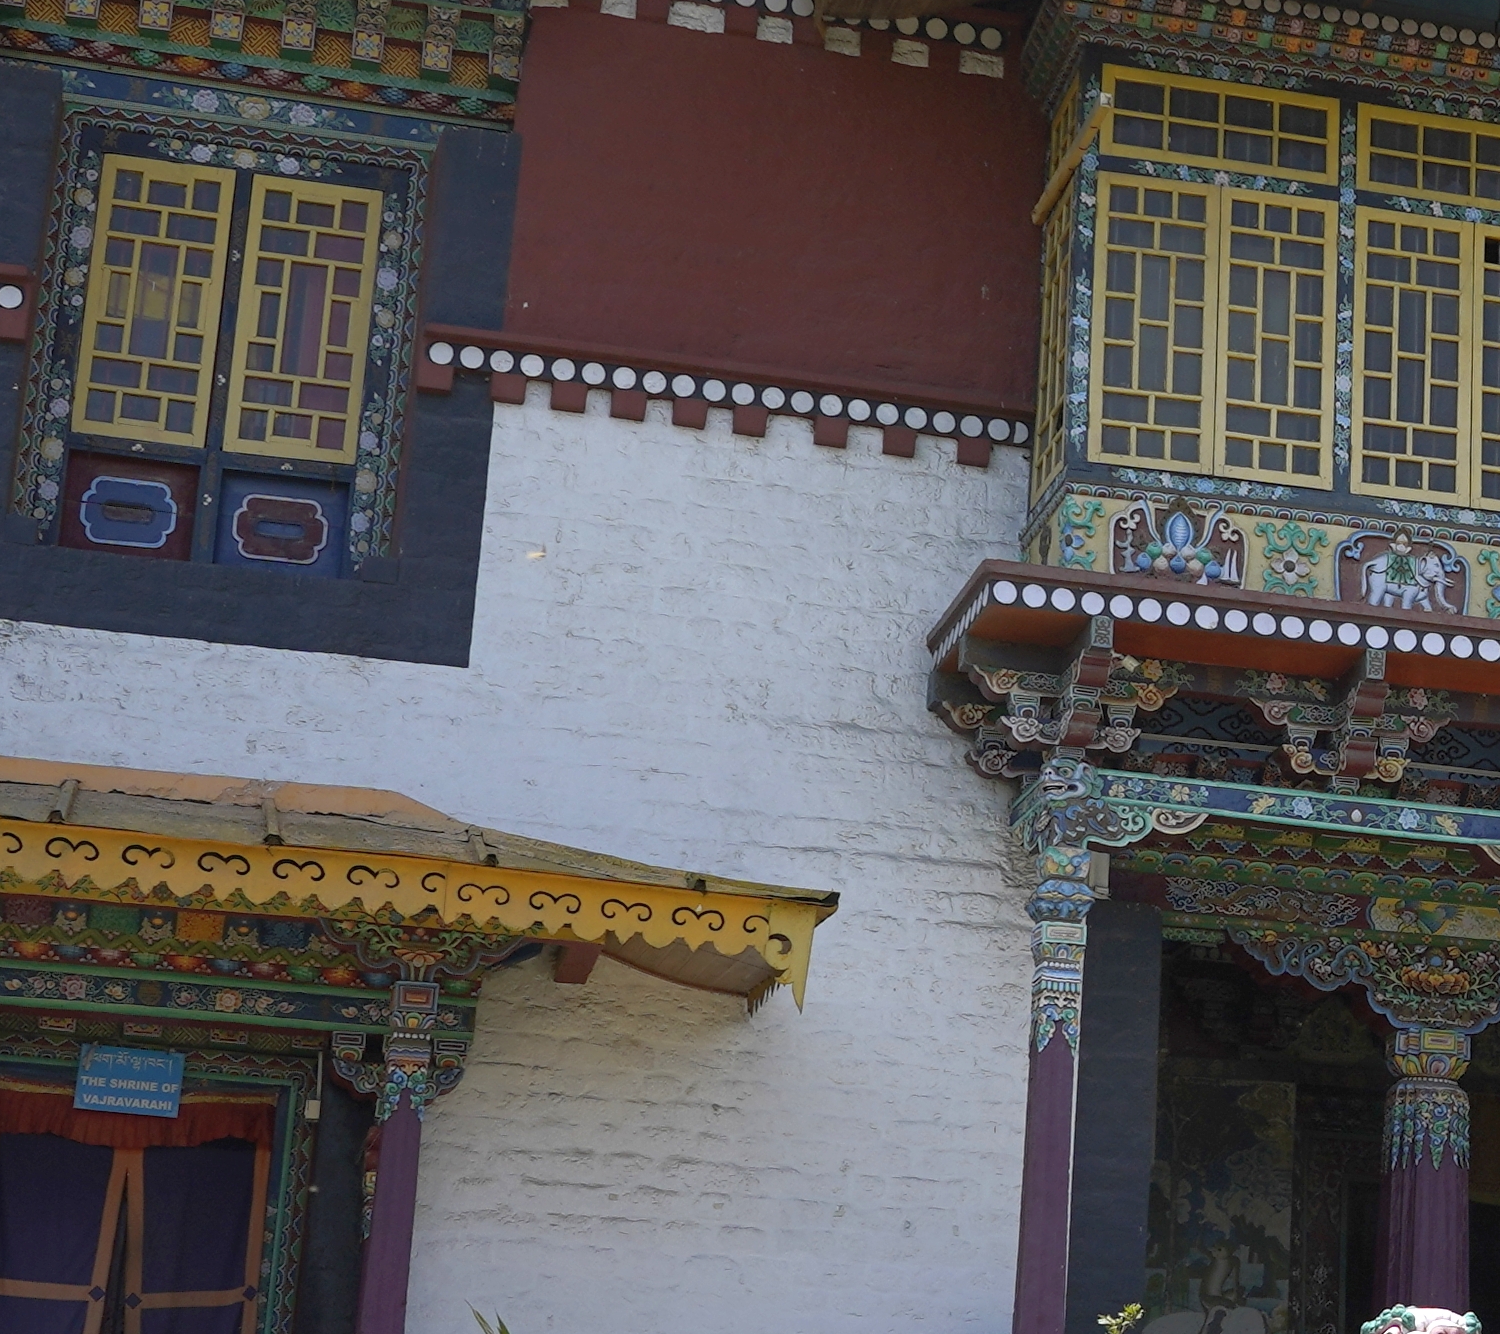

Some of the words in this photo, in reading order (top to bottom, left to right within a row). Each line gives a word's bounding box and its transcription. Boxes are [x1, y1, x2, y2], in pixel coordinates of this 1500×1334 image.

[81, 1076, 106, 1087] THE
[110, 1079, 158, 1092] SHRINE
[162, 1083, 179, 1094] OF
[83, 1094, 173, 1111] VAJRAVARAHI
